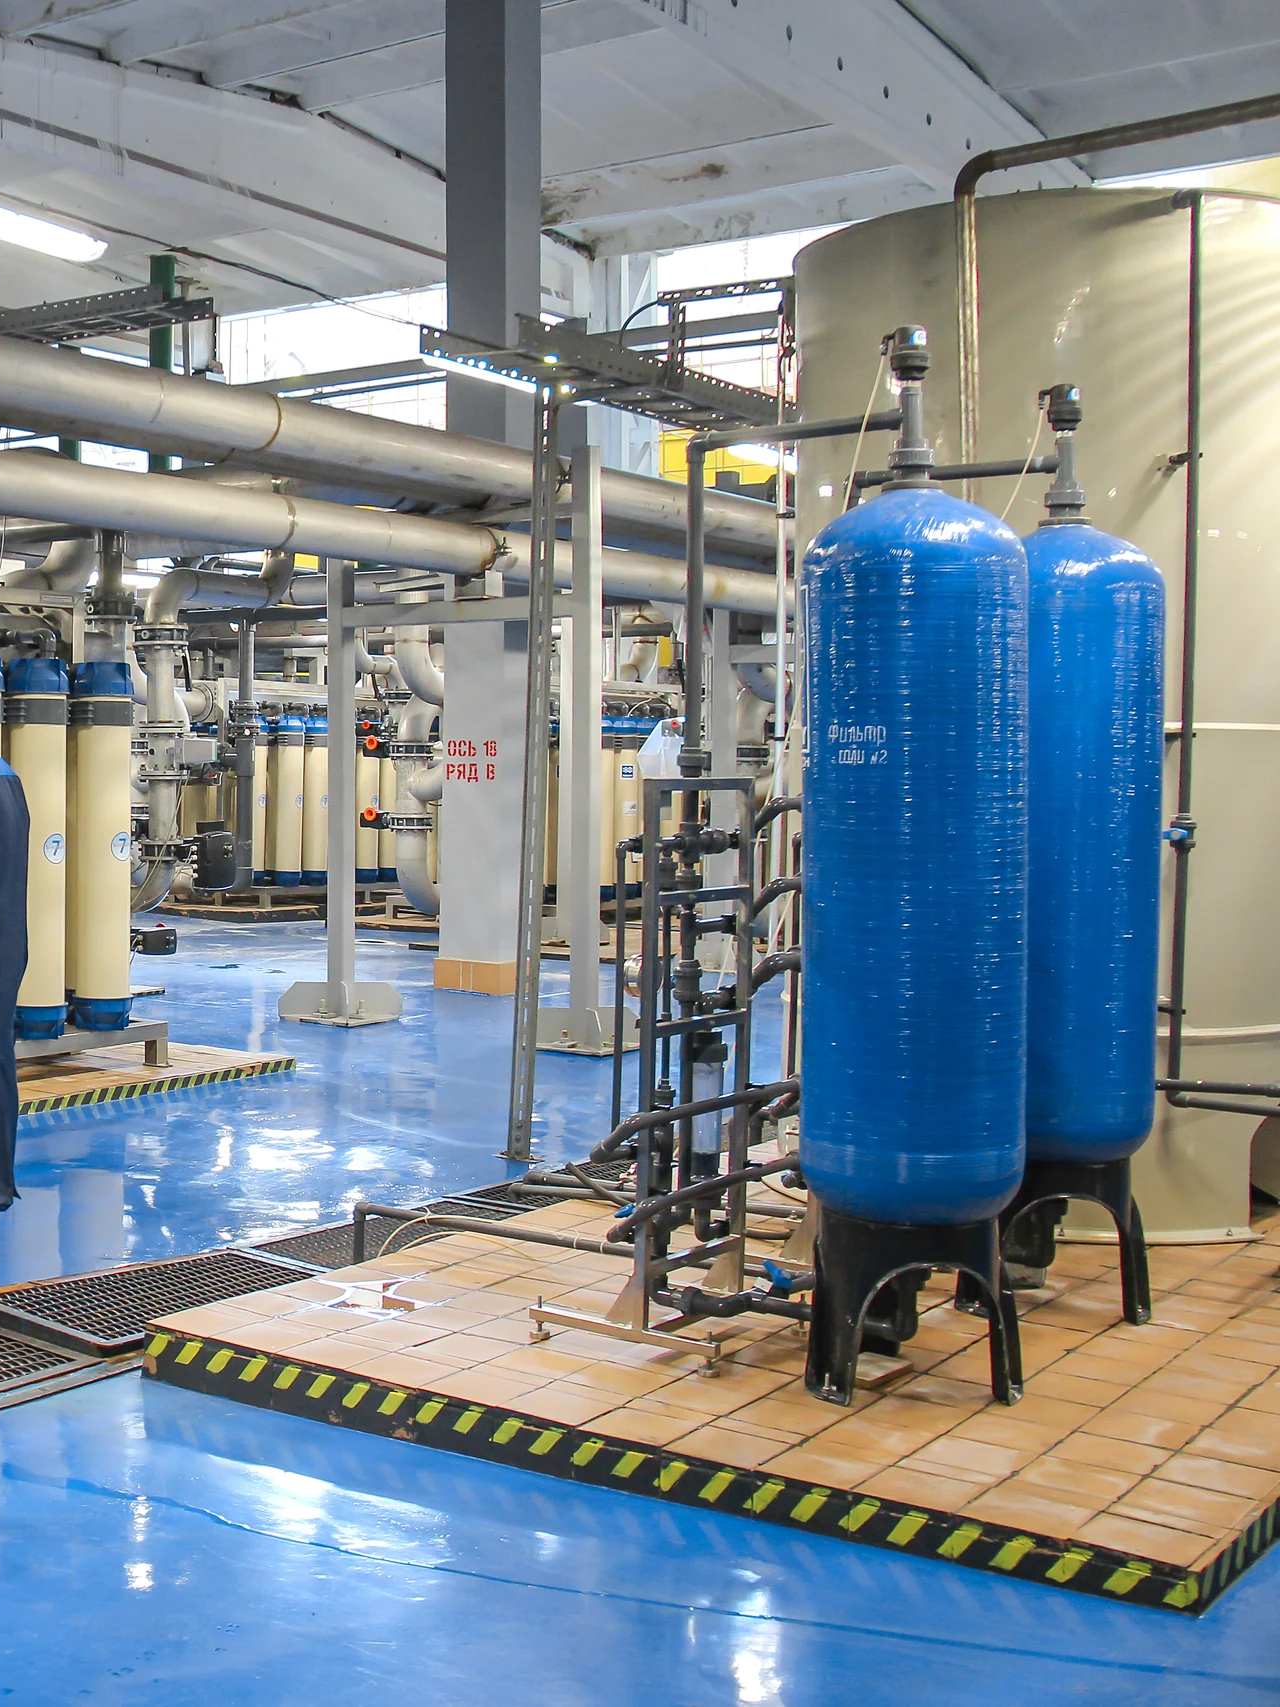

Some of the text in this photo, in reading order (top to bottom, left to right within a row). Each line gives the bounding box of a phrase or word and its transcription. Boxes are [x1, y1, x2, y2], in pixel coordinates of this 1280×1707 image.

[447, 740, 477, 757] ОСЬ
[446, 763, 496, 783] РЯД В
[52, 840, 61, 856] 7
[118, 838, 127, 854] 7
